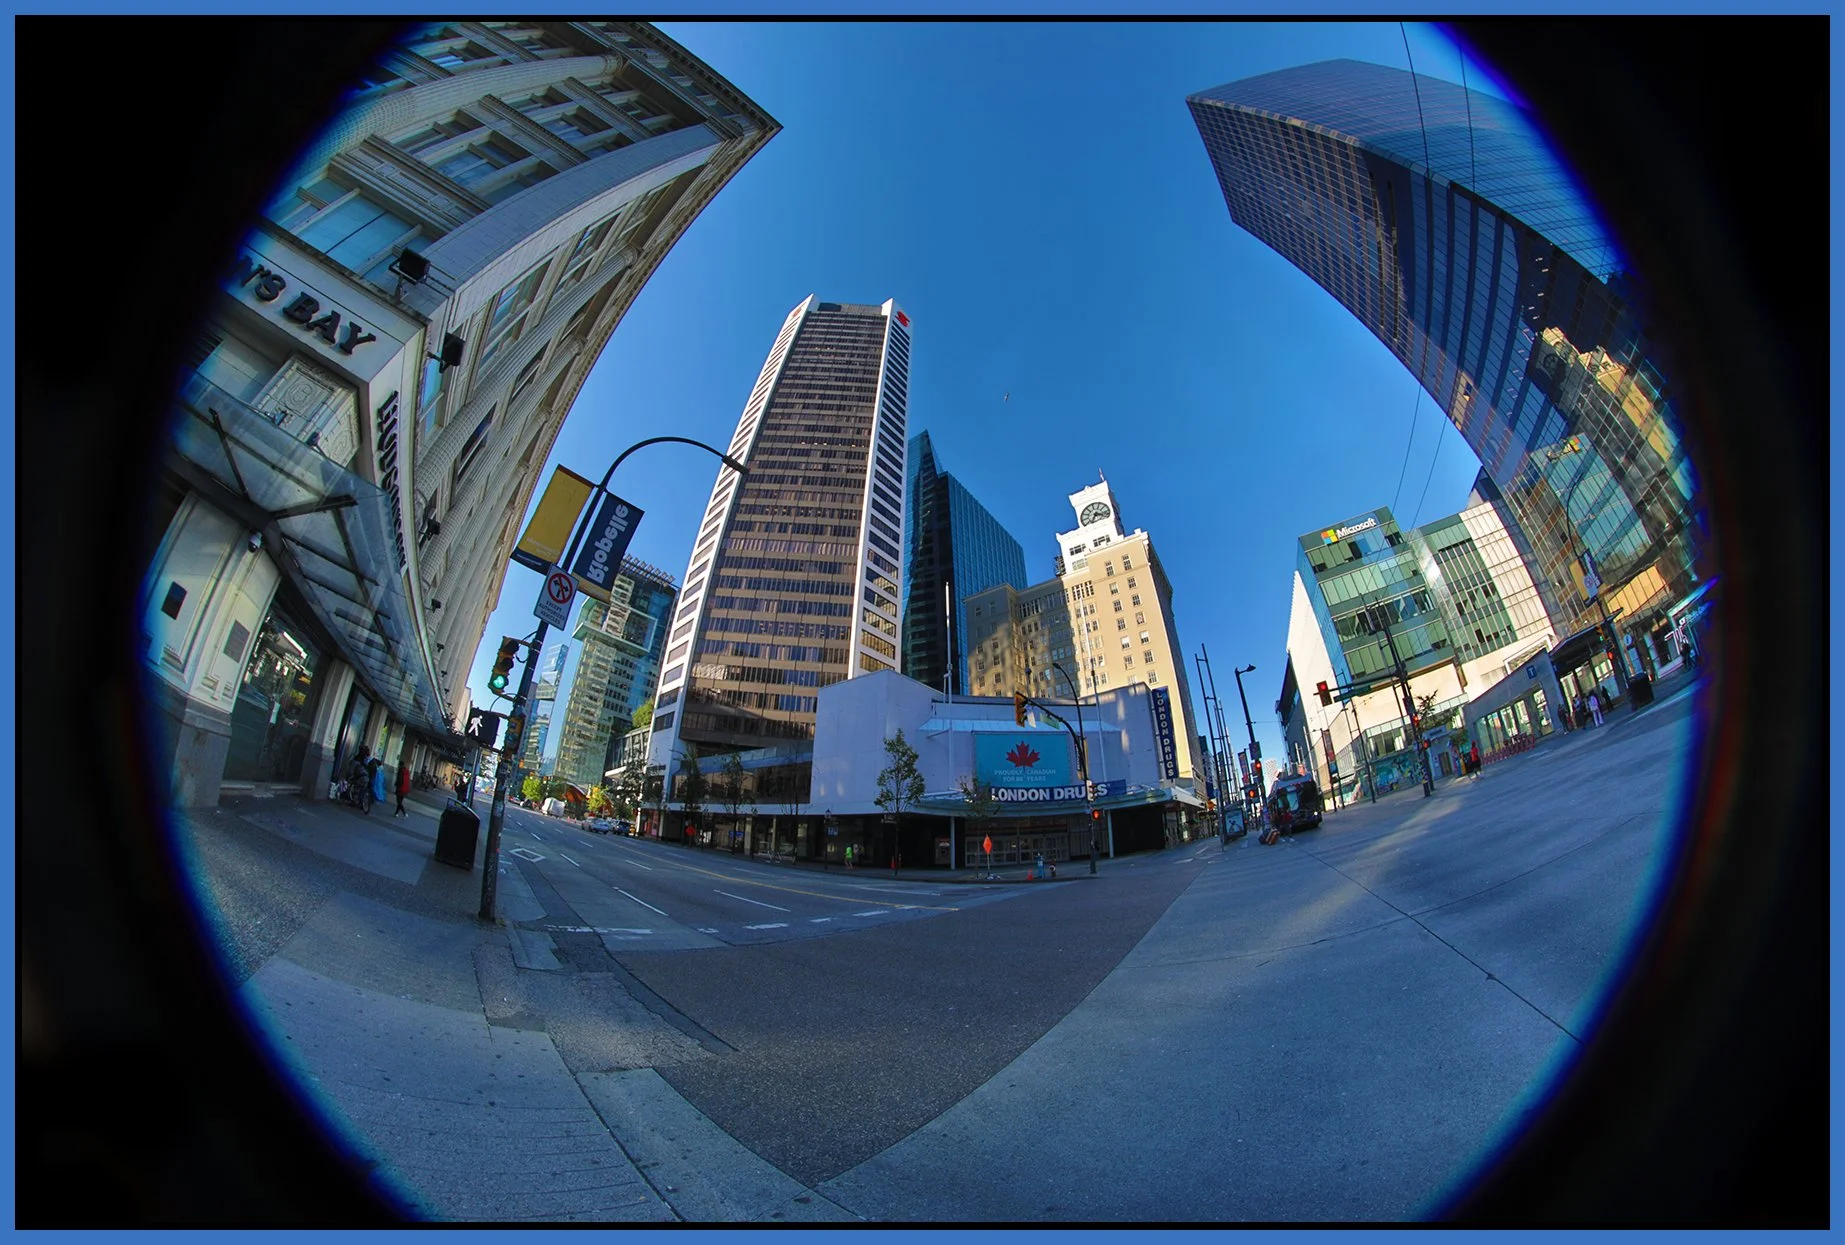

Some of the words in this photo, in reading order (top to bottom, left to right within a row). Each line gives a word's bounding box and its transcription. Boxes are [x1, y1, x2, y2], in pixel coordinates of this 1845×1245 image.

[282, 291, 377, 355] BAY
[1336, 517, 1377, 539] Microsoft
[1156, 692, 1169, 735] LONDON
[1163, 738, 1175, 777] DRUGS
[991, 787, 1050, 802] LONDON
[1053, 783, 1108, 801] DRUS
